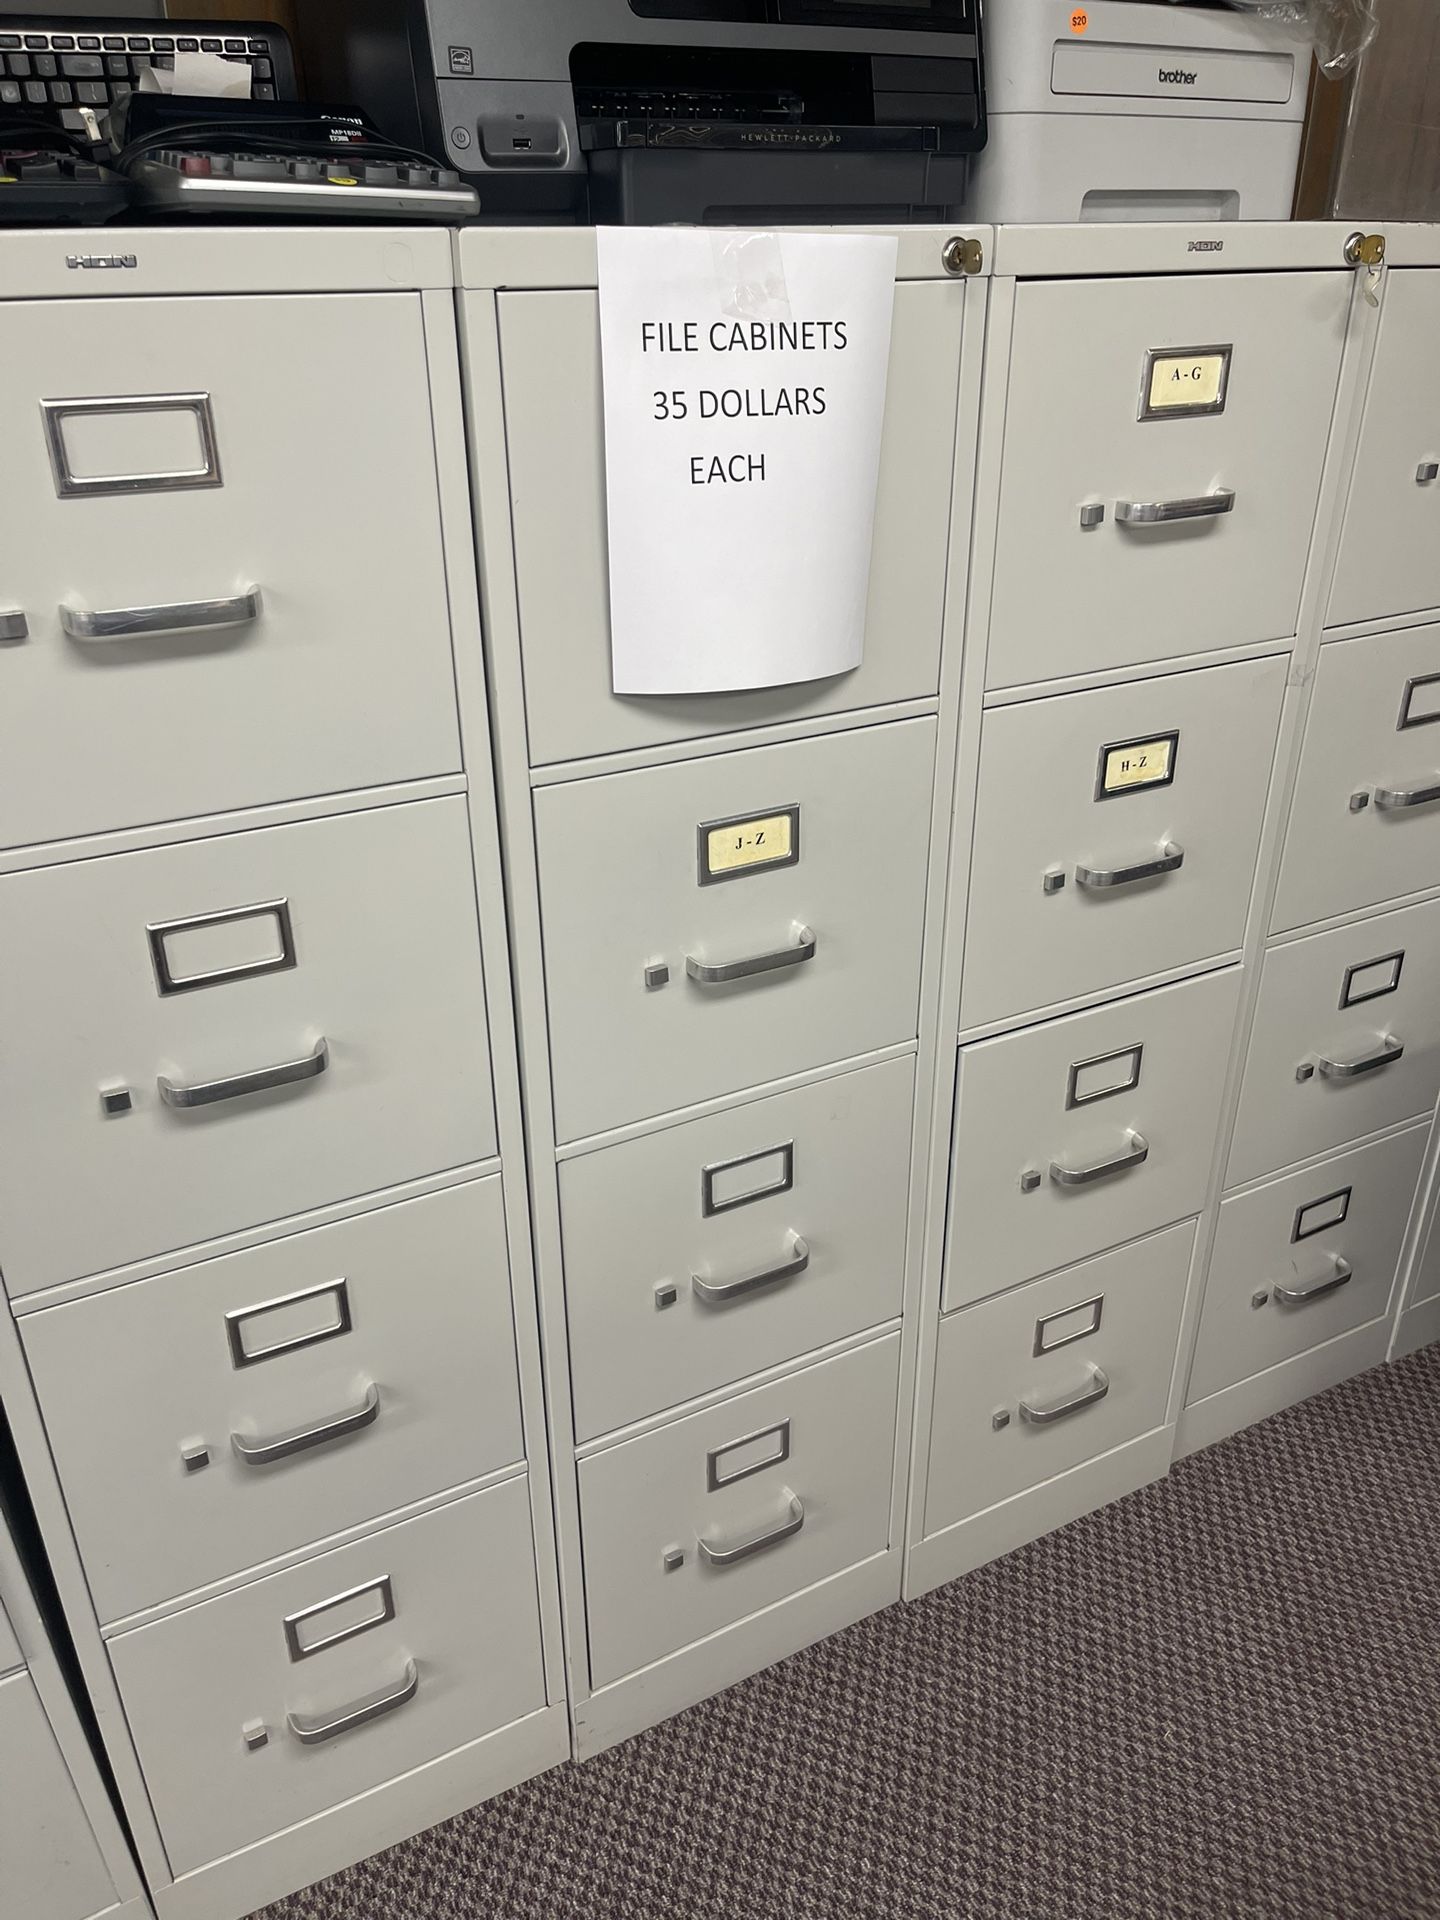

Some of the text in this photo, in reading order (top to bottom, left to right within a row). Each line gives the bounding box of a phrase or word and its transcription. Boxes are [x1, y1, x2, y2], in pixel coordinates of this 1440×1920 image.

[1071, 15, 1087, 27] $20
[1158, 68, 1198, 85] brother
[1187, 240, 1224, 252] HON
[66, 254, 137, 268] HON
[641, 321, 848, 352] FILE CABINETS
[653, 387, 827, 420] 35 DOLLARS
[690, 453, 766, 484] EACH
